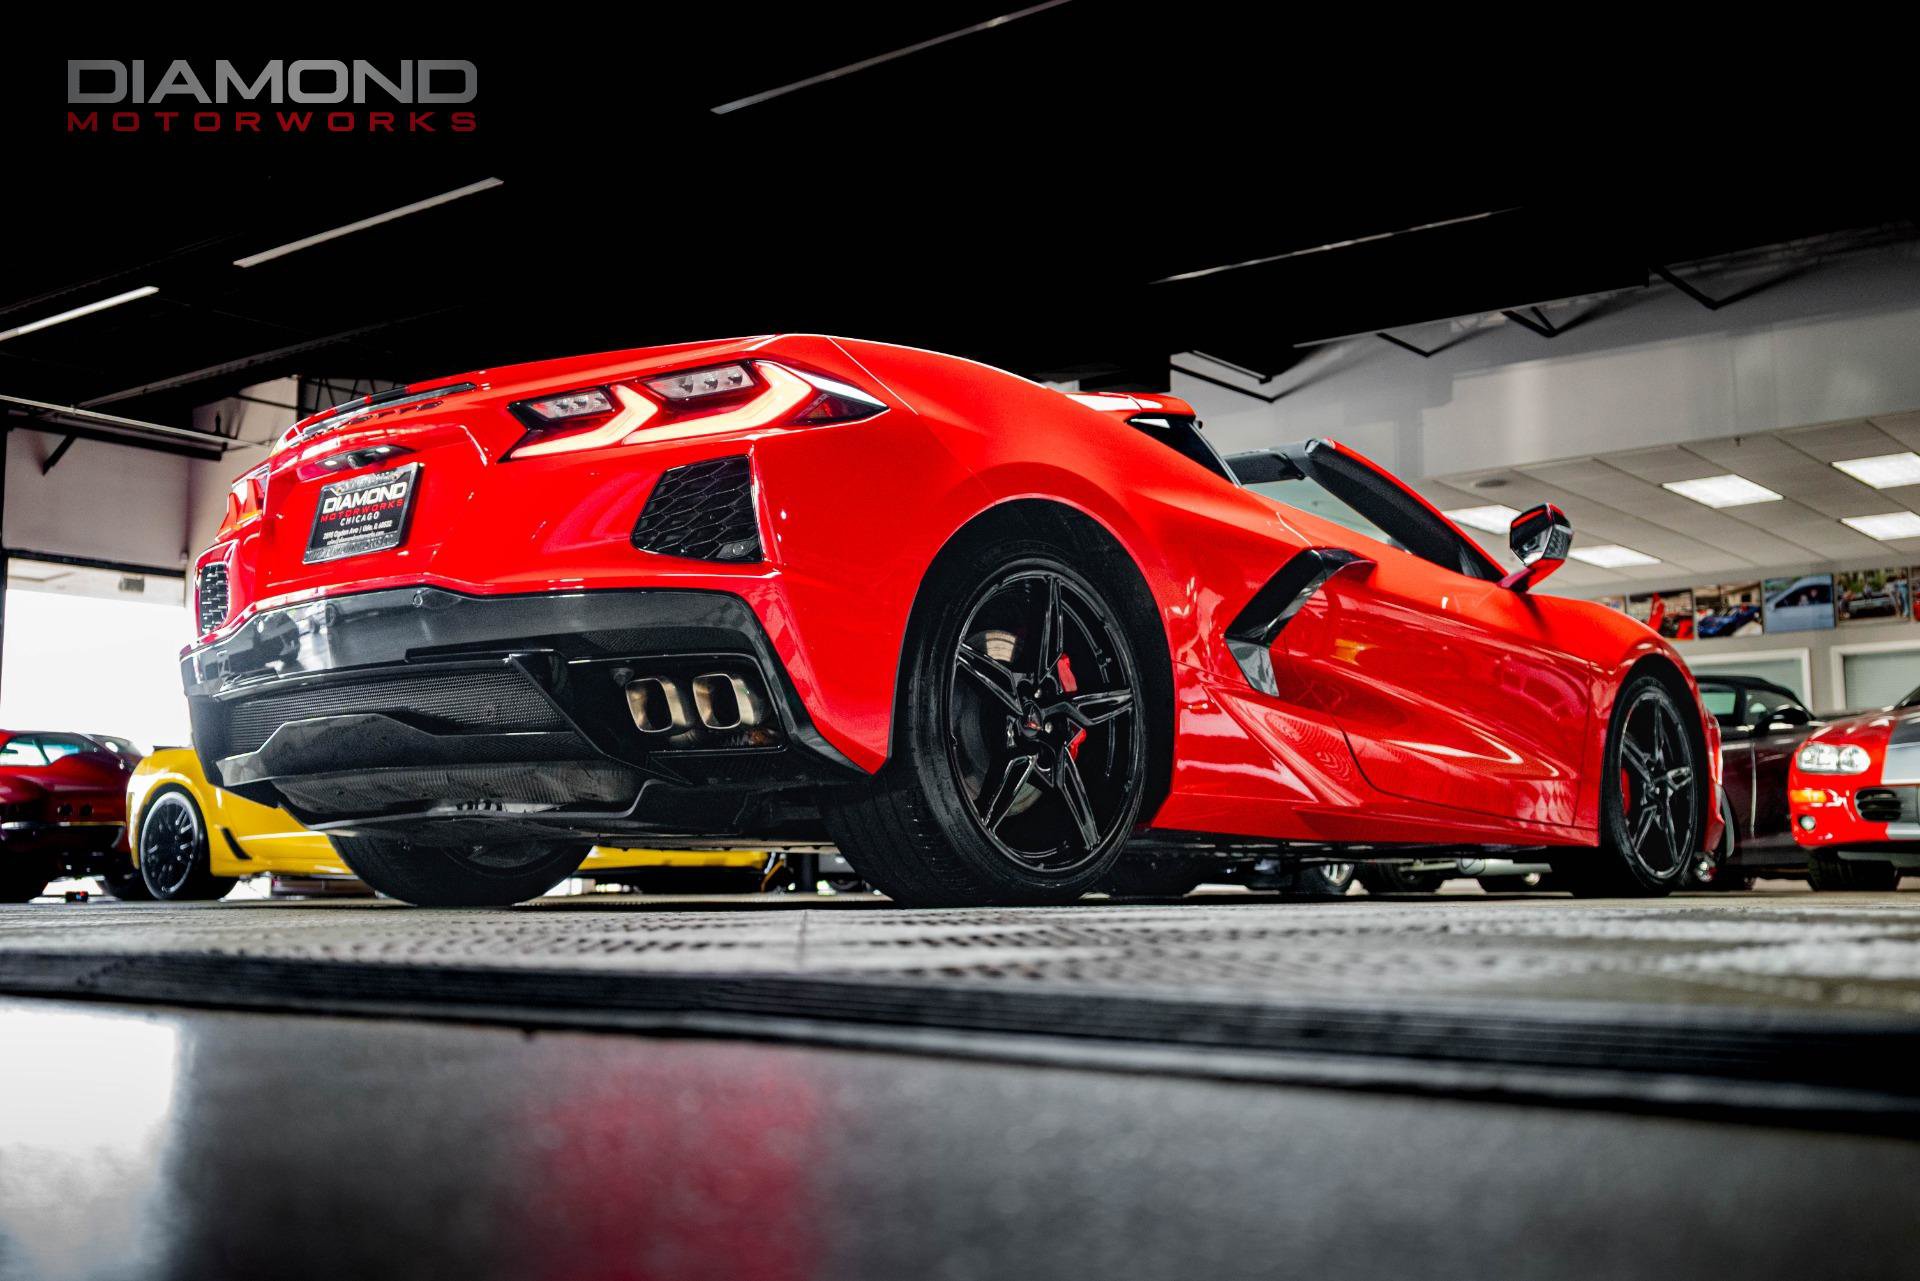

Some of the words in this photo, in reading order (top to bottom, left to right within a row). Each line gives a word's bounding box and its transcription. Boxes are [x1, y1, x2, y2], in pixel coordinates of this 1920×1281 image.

[322, 482, 408, 514] DIAMOND
[320, 499, 405, 523] MOTORWORKS
[340, 511, 380, 527] CHICAGO
